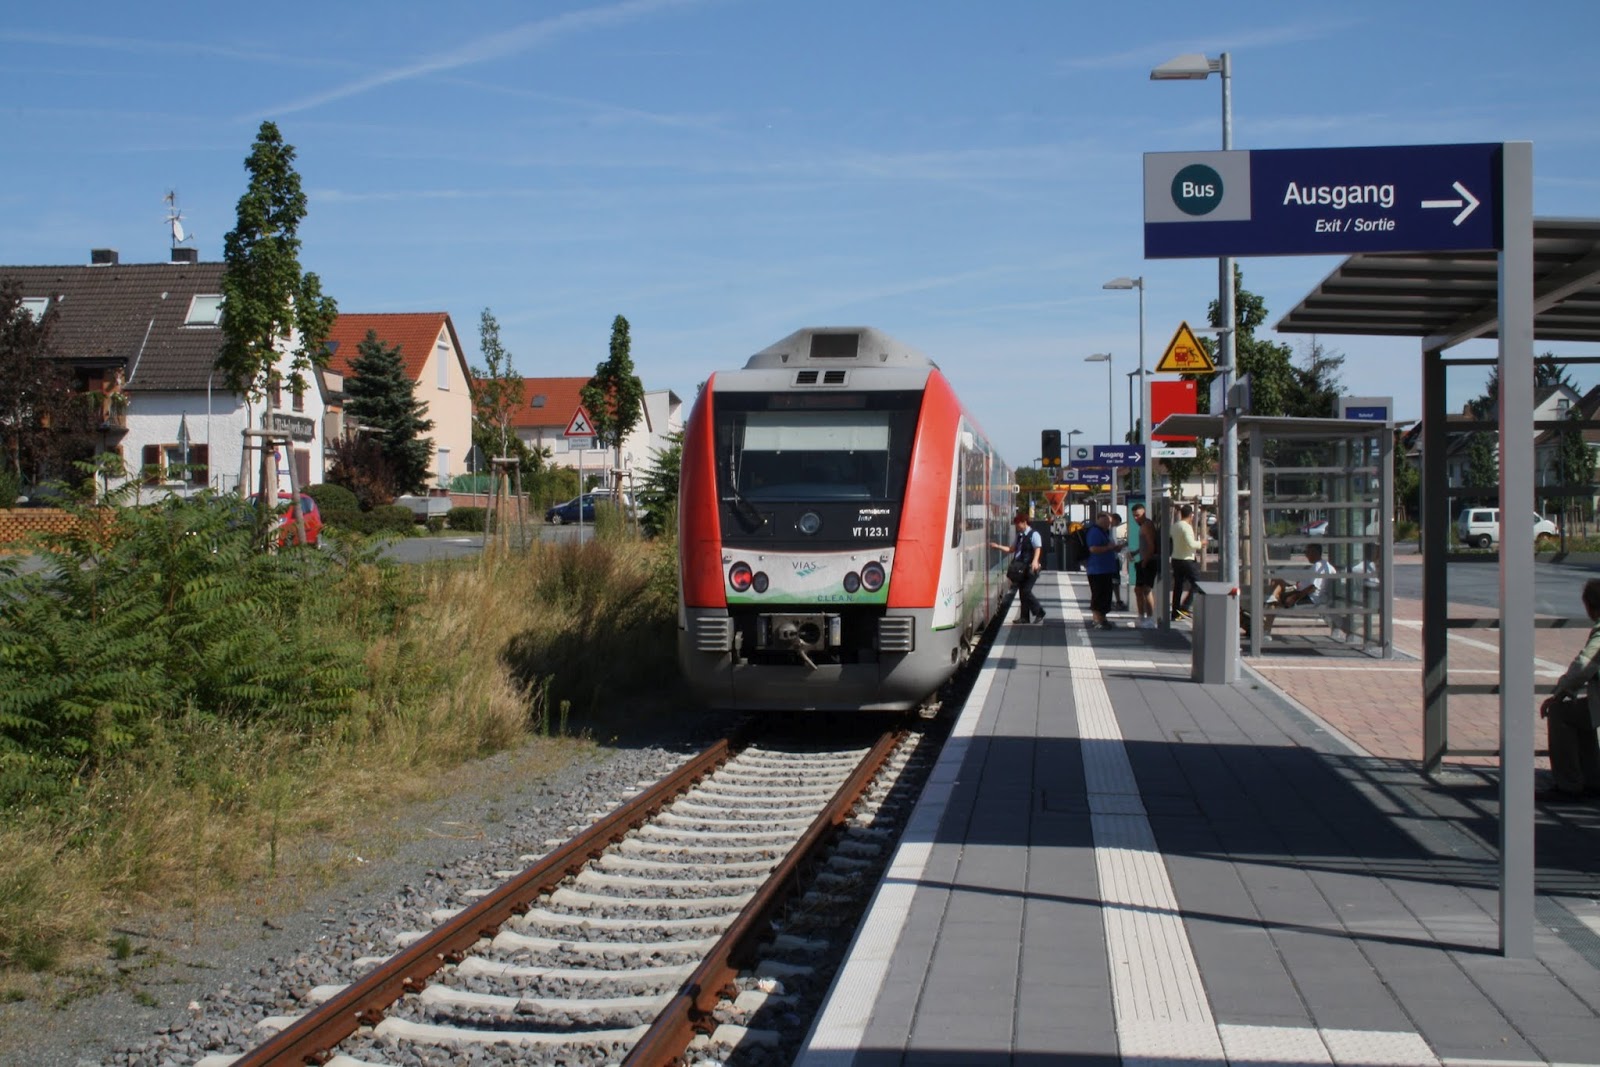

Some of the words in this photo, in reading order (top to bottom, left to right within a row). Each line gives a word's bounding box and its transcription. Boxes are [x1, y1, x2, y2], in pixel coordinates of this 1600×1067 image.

[1182, 181, 1215, 198] Bus
[1282, 181, 1396, 210] Ausgang
[1314, 218, 1342, 233] Exit
[1353, 217, 1396, 232] Sortie
[852, 526, 863, 537] VT
[864, 526, 889, 537] 123.1
[791, 560, 817, 570] VIAS
